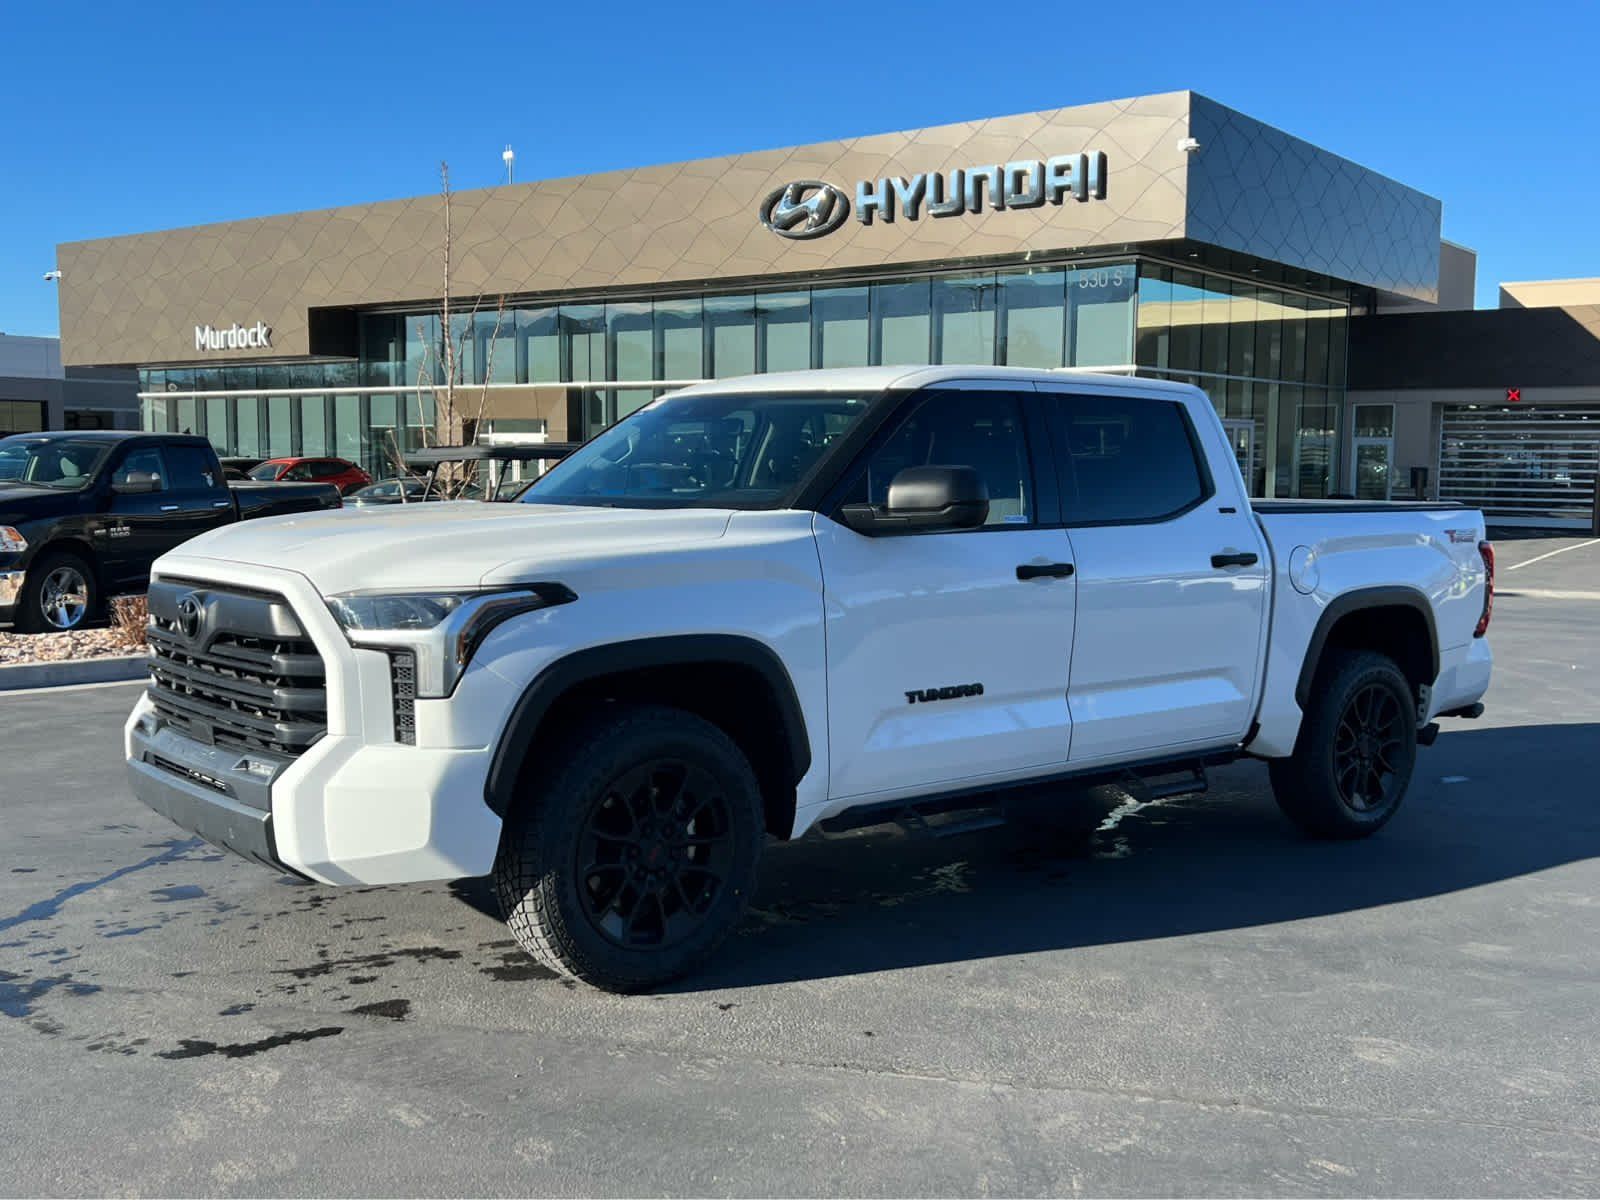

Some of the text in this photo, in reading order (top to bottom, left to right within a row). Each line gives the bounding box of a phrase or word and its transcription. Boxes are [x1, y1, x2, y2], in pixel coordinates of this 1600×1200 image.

[855, 151, 1106, 225] HYUNDAI
[1113, 269, 1123, 286] S
[195, 321, 269, 350] Murdock
[904, 683, 984, 704] TUNDRA
